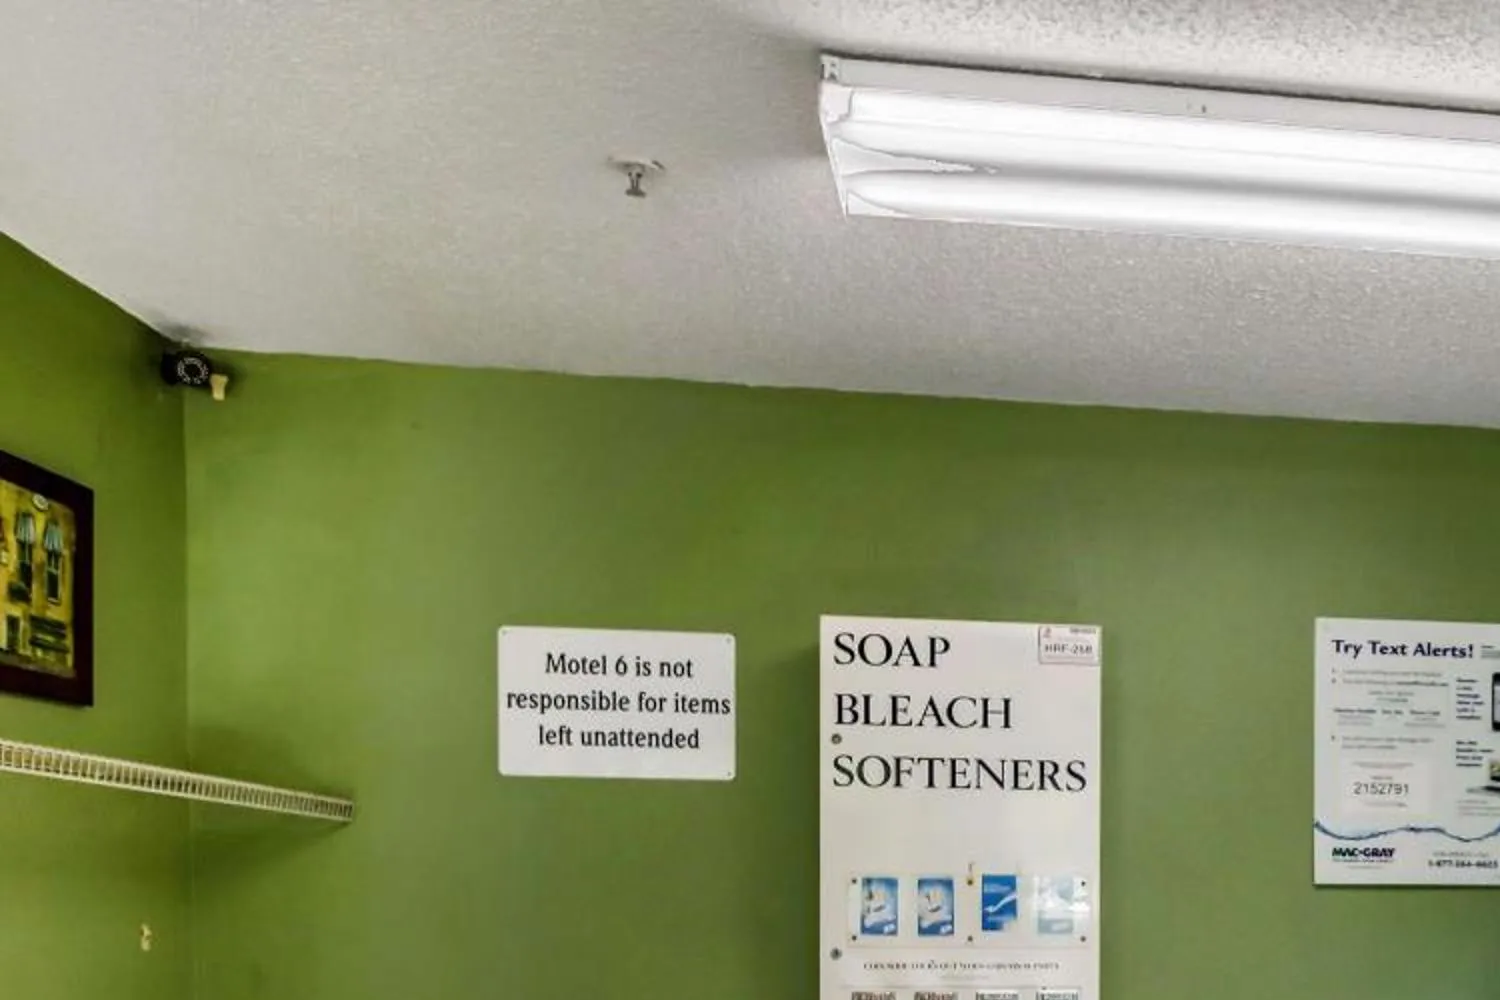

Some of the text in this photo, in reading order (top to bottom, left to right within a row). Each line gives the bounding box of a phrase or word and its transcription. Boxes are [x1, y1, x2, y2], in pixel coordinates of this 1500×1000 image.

[833, 632, 950, 668] SOAP
[1331, 640, 1362, 659] Try
[1368, 641, 1407, 657] Text
[1413, 643, 1474, 659] Alerts!
[545, 653, 694, 678] Motel 6 is not
[506, 690, 731, 715] responsible for items
[835, 693, 1013, 729] BLEACH
[539, 725, 700, 749] left unattended
[833, 754, 1087, 792] SOFTENERS
